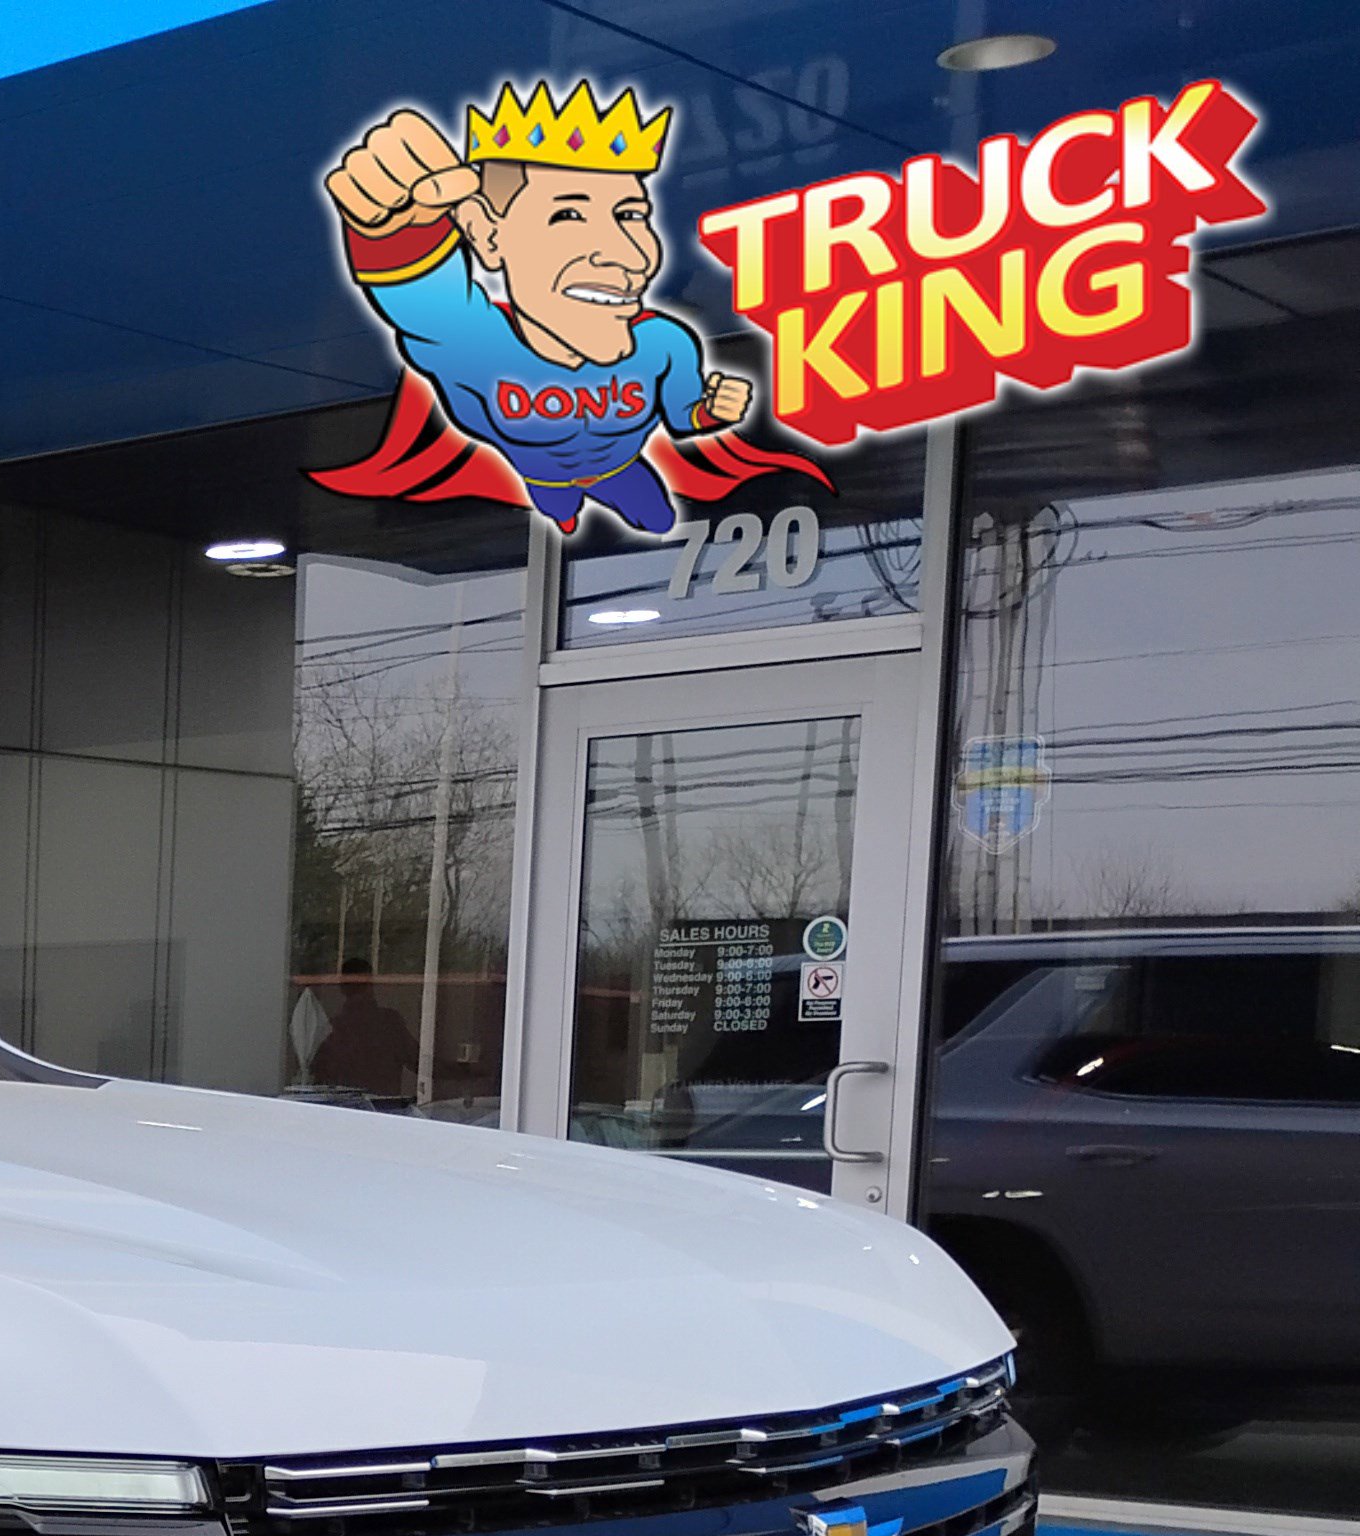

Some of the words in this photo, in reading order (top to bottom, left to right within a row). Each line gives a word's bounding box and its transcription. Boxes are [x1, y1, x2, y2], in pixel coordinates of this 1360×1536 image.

[661, 505, 820, 601] 720
[660, 927, 710, 942] SALES
[714, 924, 770, 939] HOURS
[654, 948, 696, 959] Monday
[654, 961, 695, 972] Tuesday
[652, 985, 700, 997] Thursday
[650, 1023, 689, 1034] Sunday
[713, 1020, 768, 1032] CLOSED
